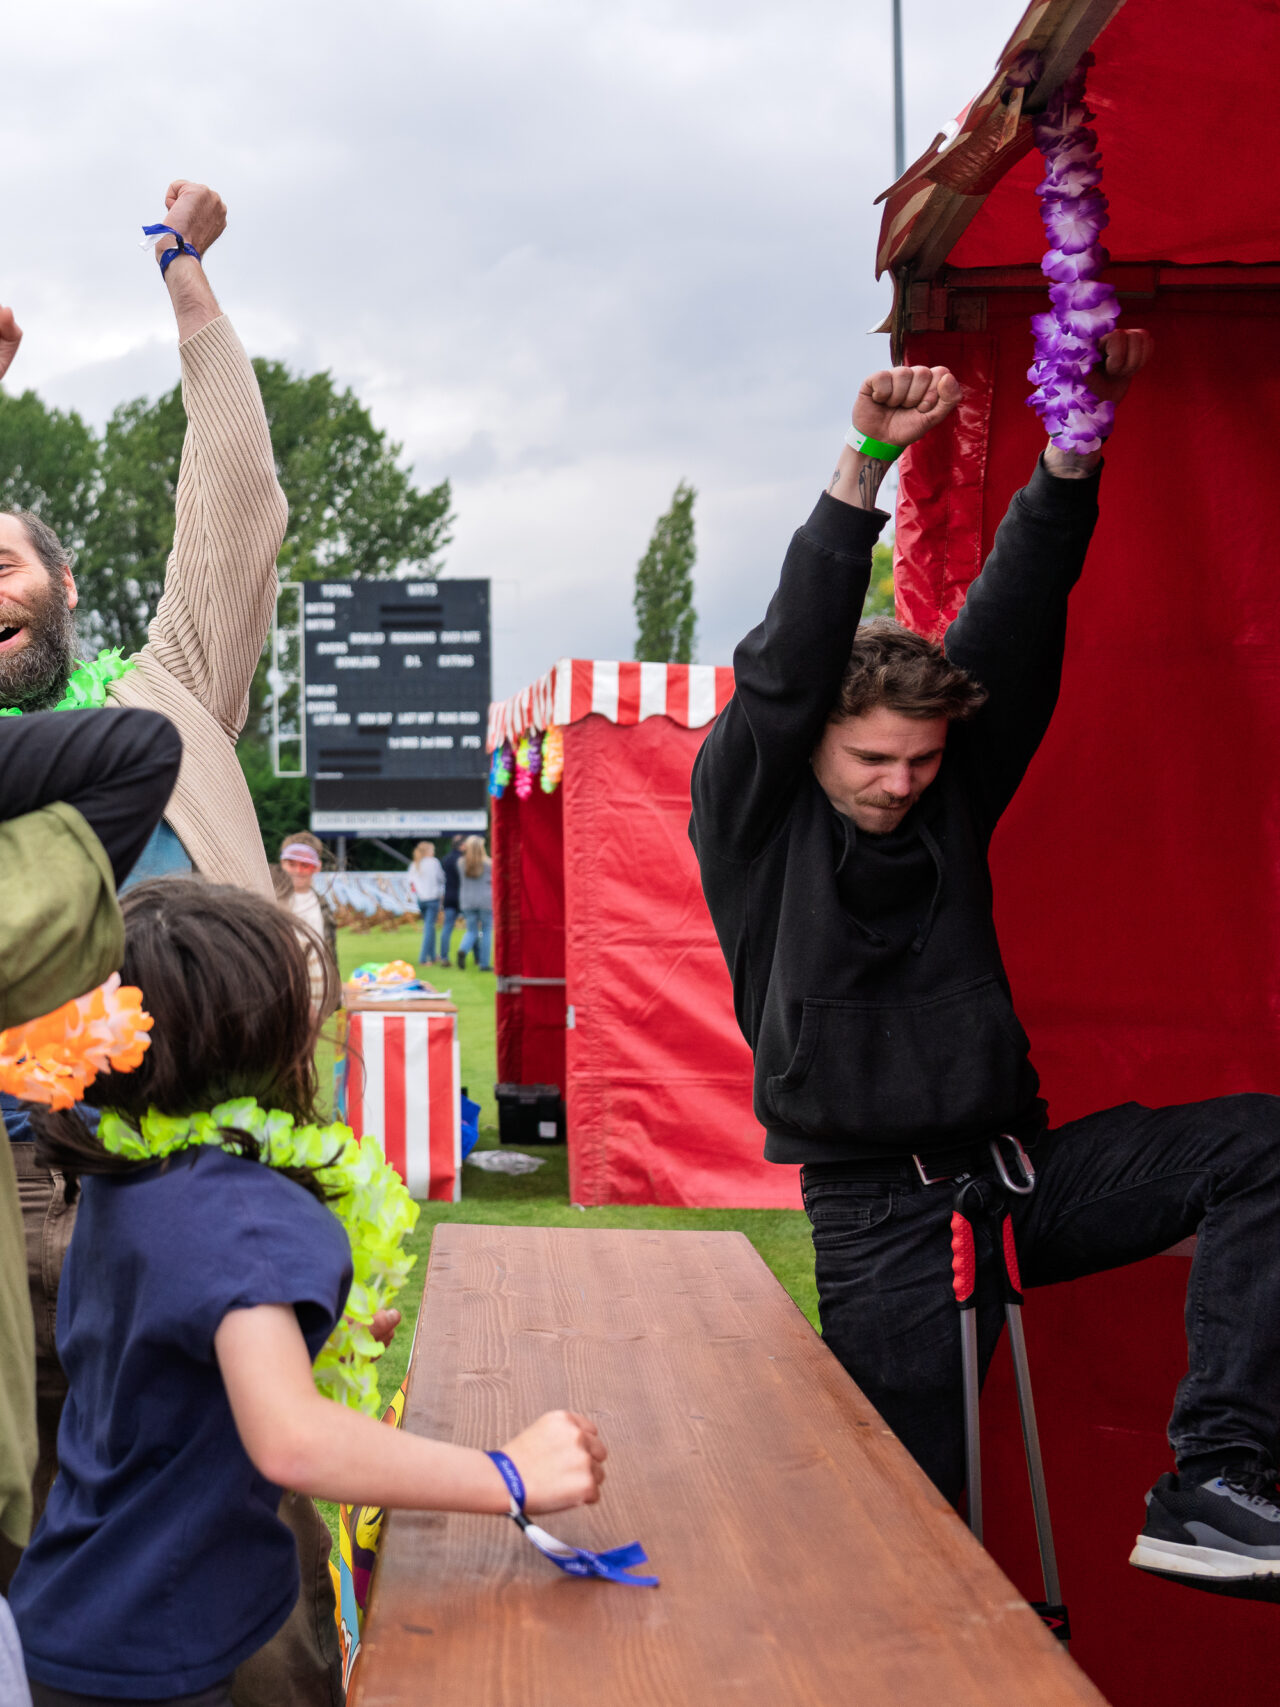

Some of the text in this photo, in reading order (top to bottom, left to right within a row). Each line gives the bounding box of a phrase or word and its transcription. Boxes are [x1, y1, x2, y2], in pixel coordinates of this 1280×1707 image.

[321, 584, 354, 598] TOTAL
[407, 583, 438, 597] WKTS
[317, 642, 349, 654] OVERS
[335, 656, 380, 669] BOWLERS
[438, 655, 475, 668] EXTRAS
[306, 701, 337, 713] OVERS
[461, 736, 481, 748] PTS
